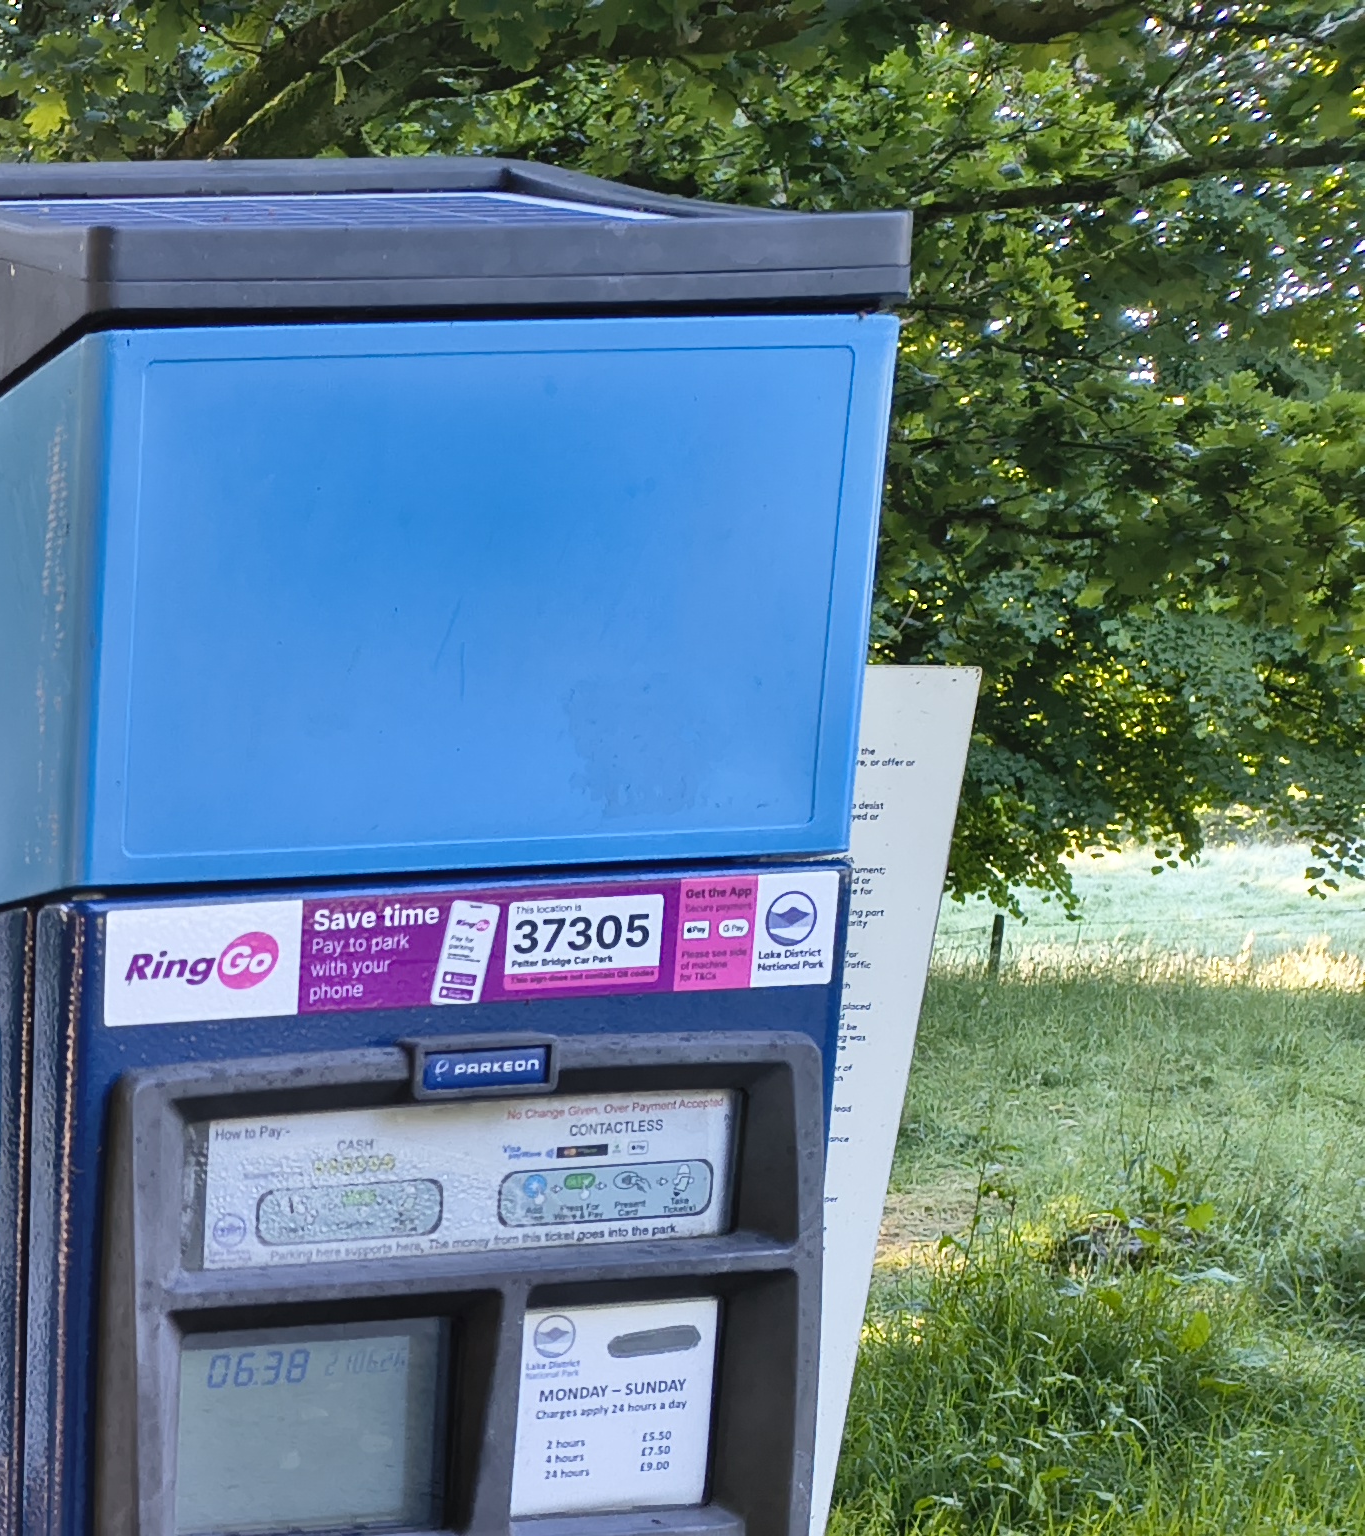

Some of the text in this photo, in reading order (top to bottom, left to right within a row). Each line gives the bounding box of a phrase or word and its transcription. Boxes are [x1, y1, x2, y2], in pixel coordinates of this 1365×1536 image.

[861, 747, 876, 756] the
[313, 906, 440, 931] Save time
[516, 904, 582, 915] This location is
[513, 913, 650, 954] 37305
[311, 933, 409, 956] Pay to park
[758, 947, 821, 960] Lake District
[124, 945, 271, 986] RingGo
[310, 959, 391, 977] with your
[511, 954, 613, 968] Pelter Bridge Car Park
[757, 959, 824, 972] National Park
[309, 982, 363, 1003] phone
[454, 1058, 539, 1075] PARKEON
[569, 1119, 663, 1137] CONTACTLESS
[538, 1378, 686, 1402] MONDAY SUNDAY
